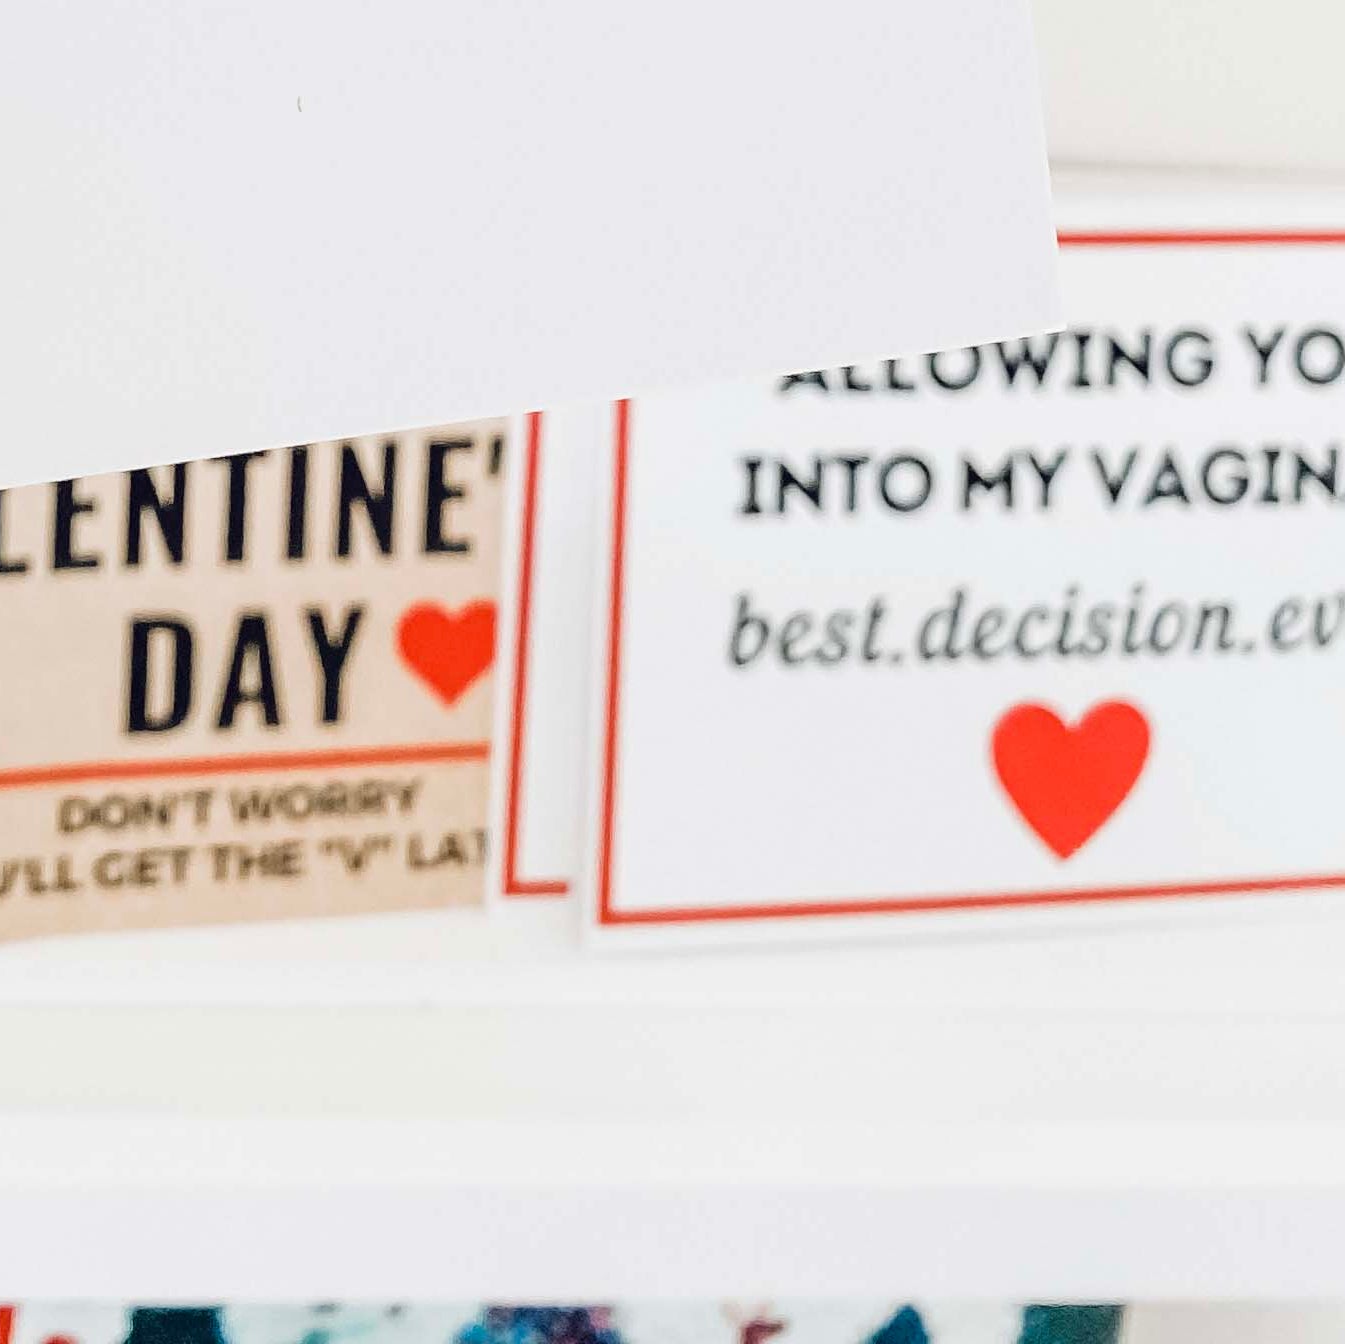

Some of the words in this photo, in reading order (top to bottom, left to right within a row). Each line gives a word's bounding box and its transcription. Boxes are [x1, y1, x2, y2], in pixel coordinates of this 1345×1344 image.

[740, 454, 933, 514] INTO
[959, 450, 1068, 509] MY
[1092, 446, 1345, 506] VAGIN
[124, 604, 364, 736] DAY
[56, 789, 212, 834] DON'T
[230, 778, 422, 824] WORRY
[92, 844, 192, 890] GET
[209, 839, 304, 881] THE
